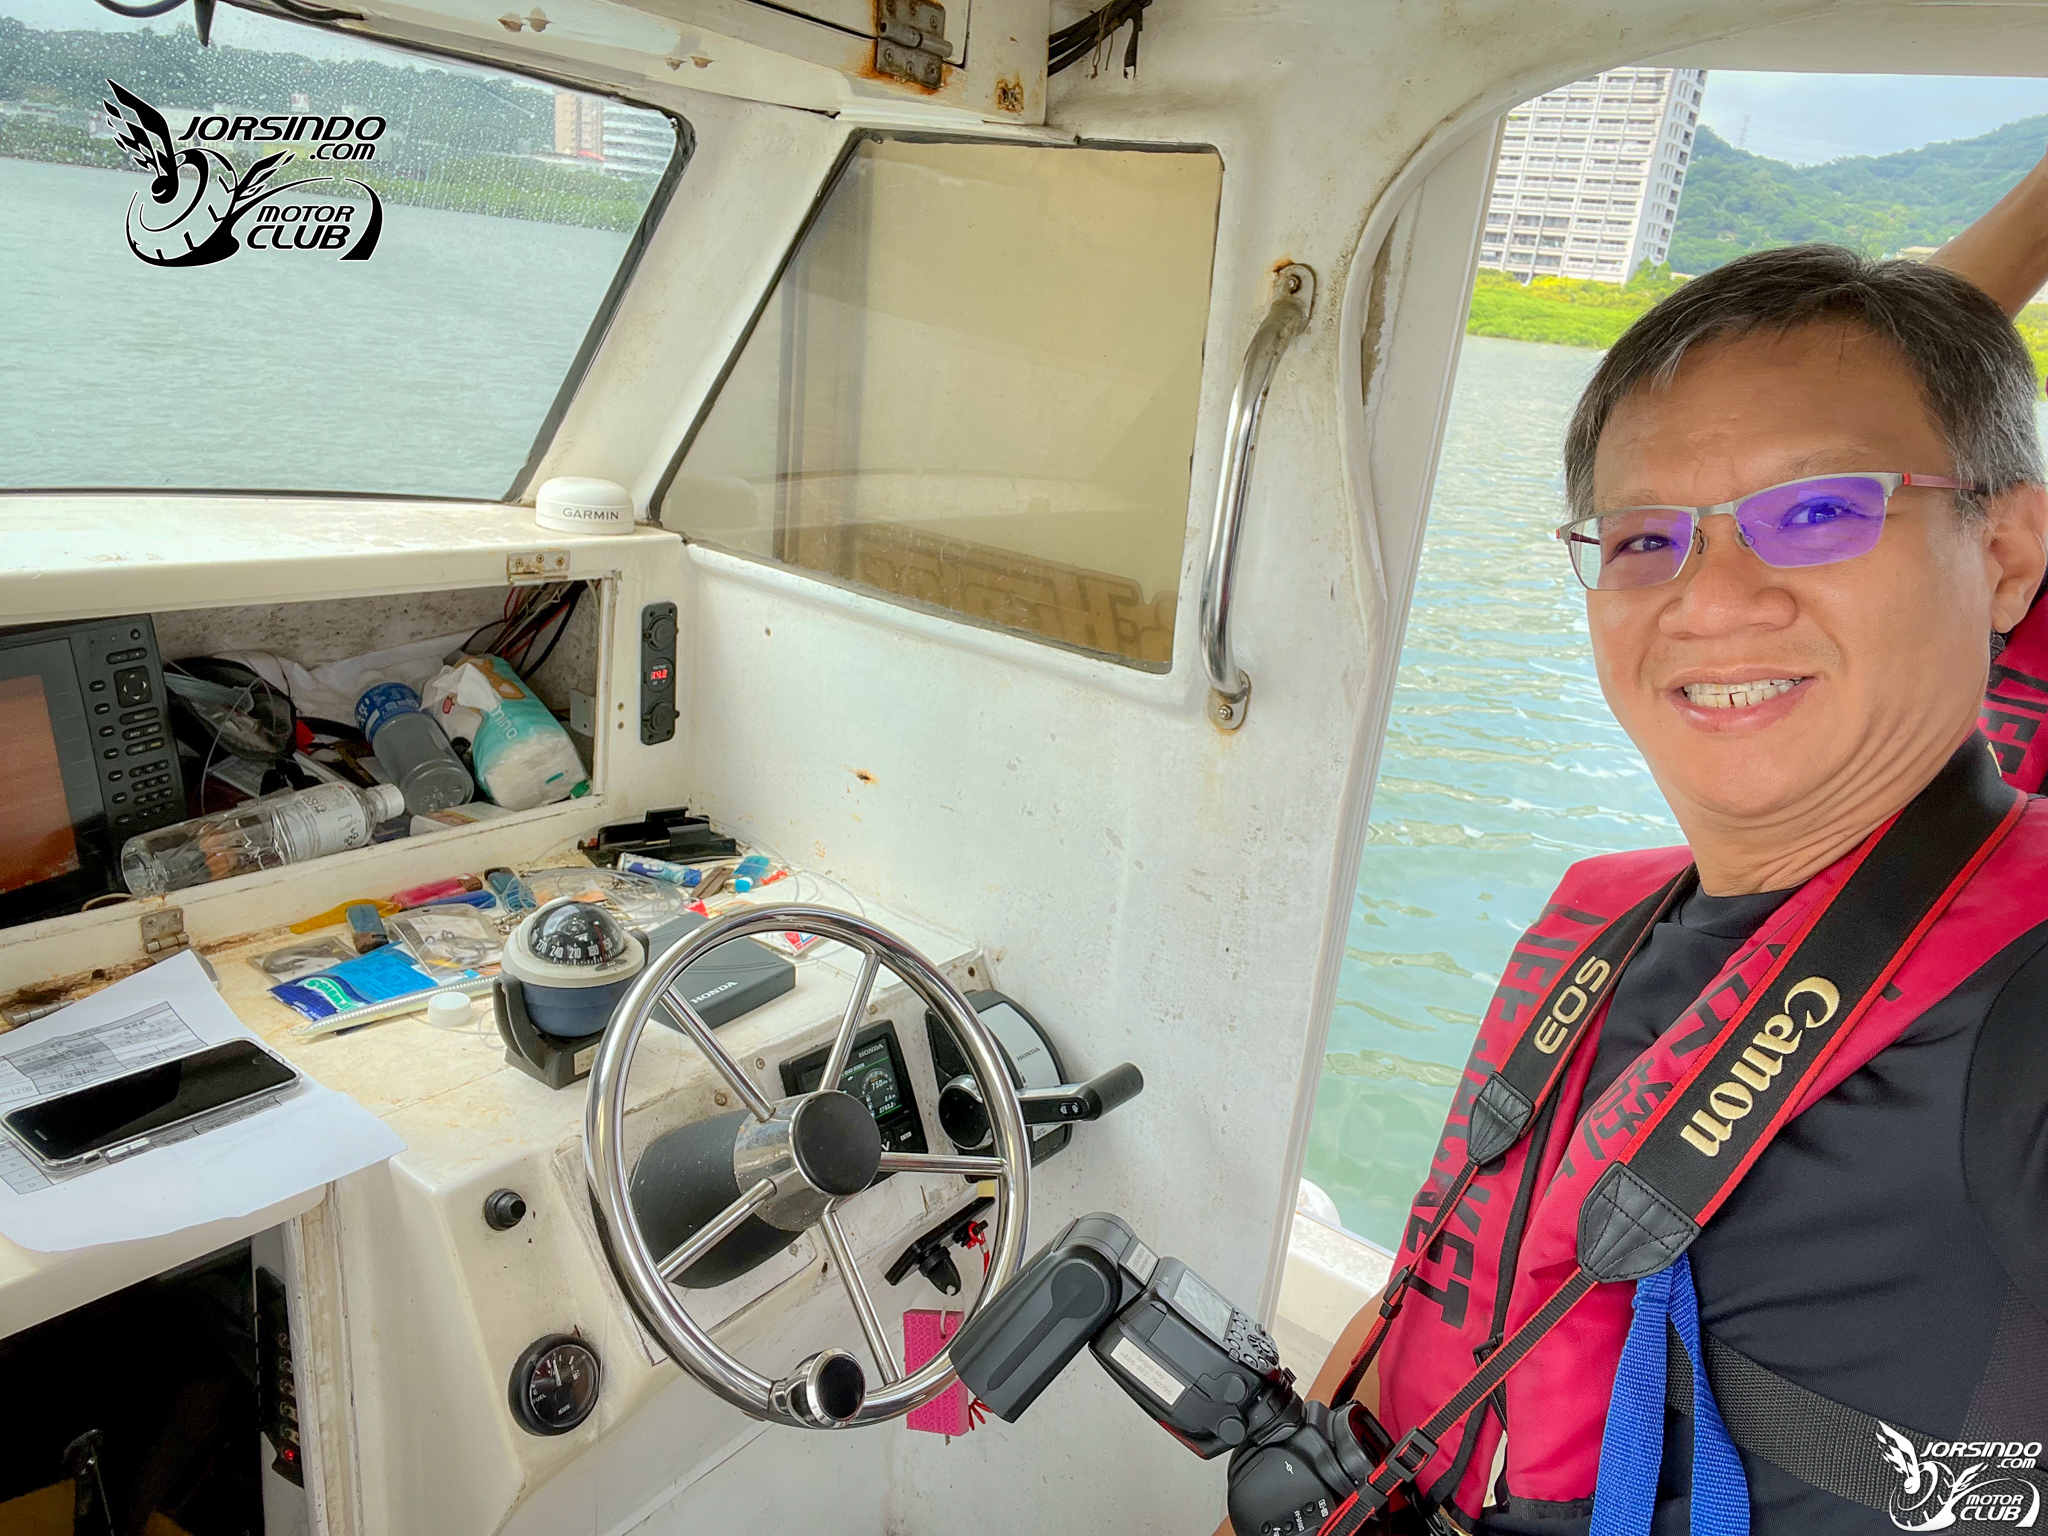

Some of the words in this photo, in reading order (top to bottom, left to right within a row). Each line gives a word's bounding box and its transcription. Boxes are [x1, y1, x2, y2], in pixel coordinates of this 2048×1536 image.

[563, 507, 619, 520] GARMIN
[549, 945, 564, 959] 240
[569, 947, 582, 959] 210
[690, 981, 739, 1004] HONDA
[1533, 955, 1611, 1055] EOS
[858, 1043, 884, 1058] HONDA
[1016, 1046, 1041, 1062] HONDA
[1680, 976, 1841, 1157] Canon
[532, 1393, 546, 1404] FUEL
